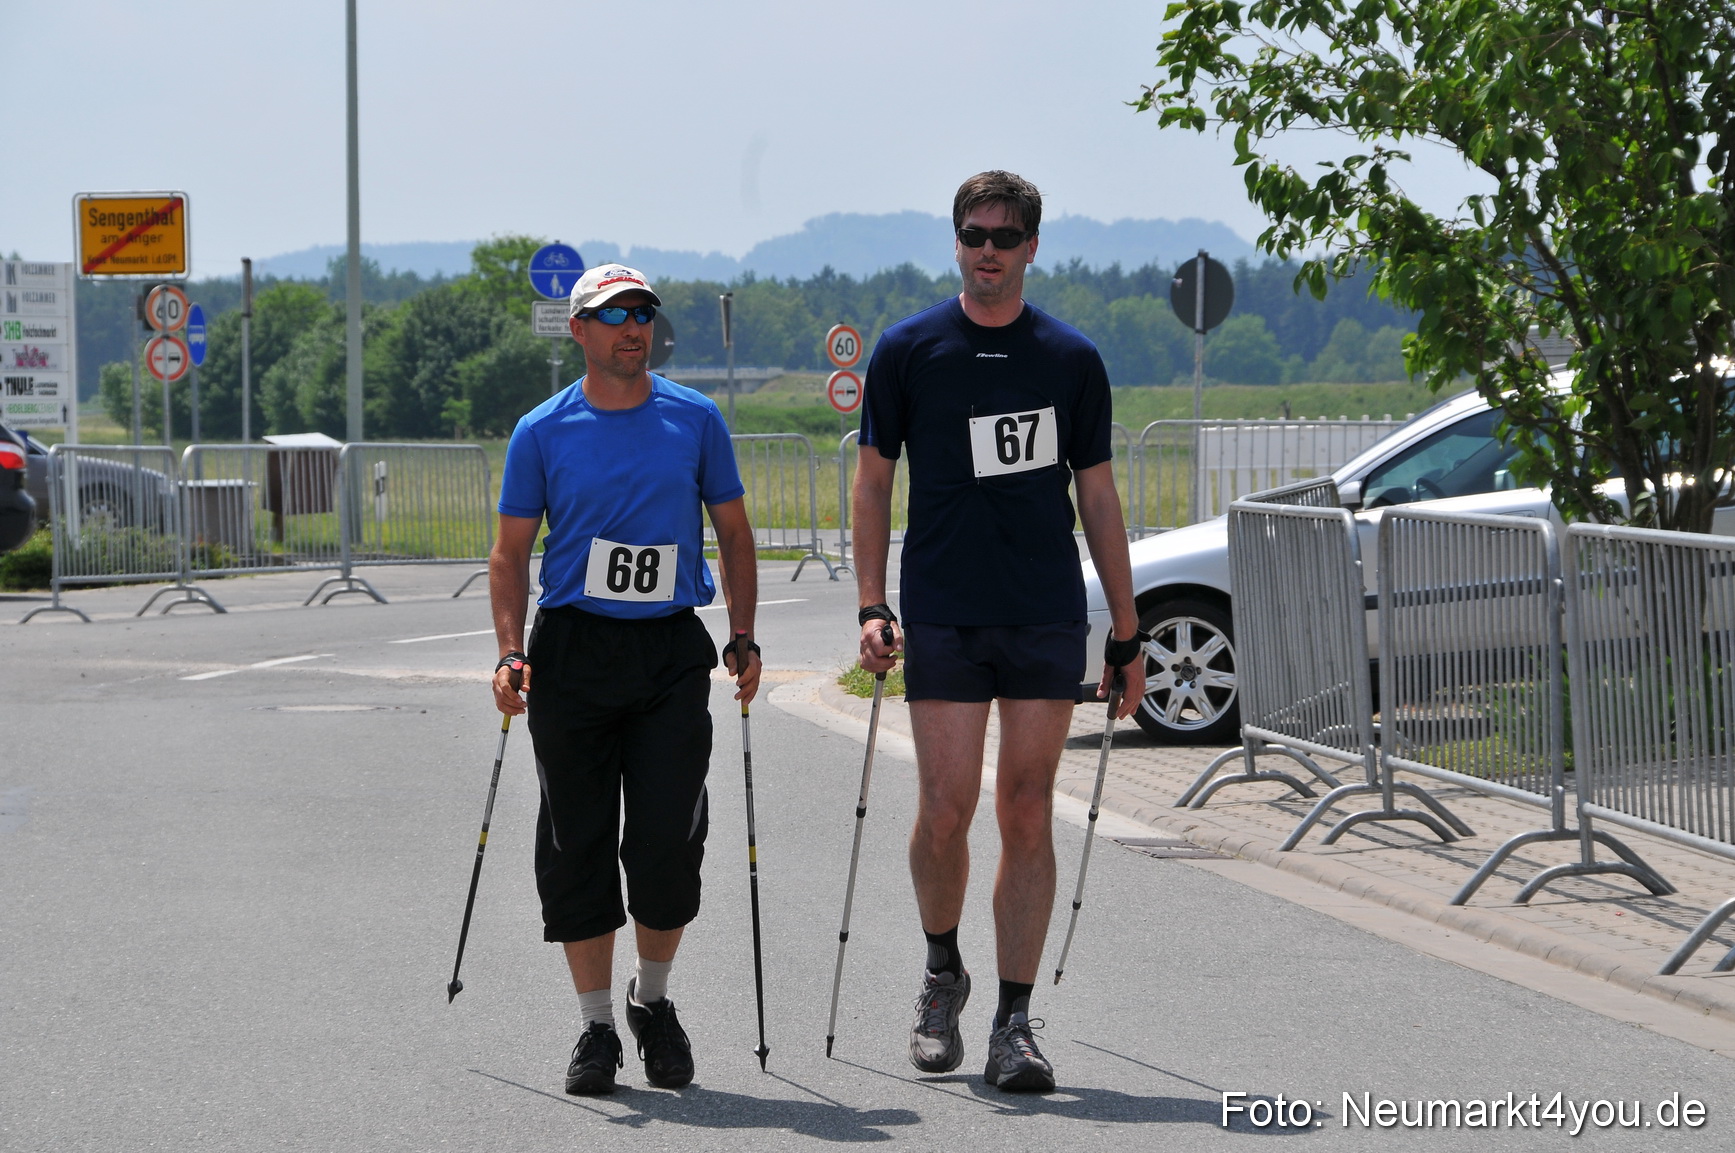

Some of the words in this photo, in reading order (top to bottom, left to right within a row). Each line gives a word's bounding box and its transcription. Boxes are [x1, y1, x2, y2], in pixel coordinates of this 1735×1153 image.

[88, 207, 175, 231] Sengenthal
[100, 234, 119, 244] am
[125, 233, 164, 246] Anger
[110, 254, 149, 265] Neumarkt
[835, 337, 855, 356] 60
[4, 376, 34, 396] THULE
[994, 412, 1041, 466] 67
[606, 546, 661, 594] 68
